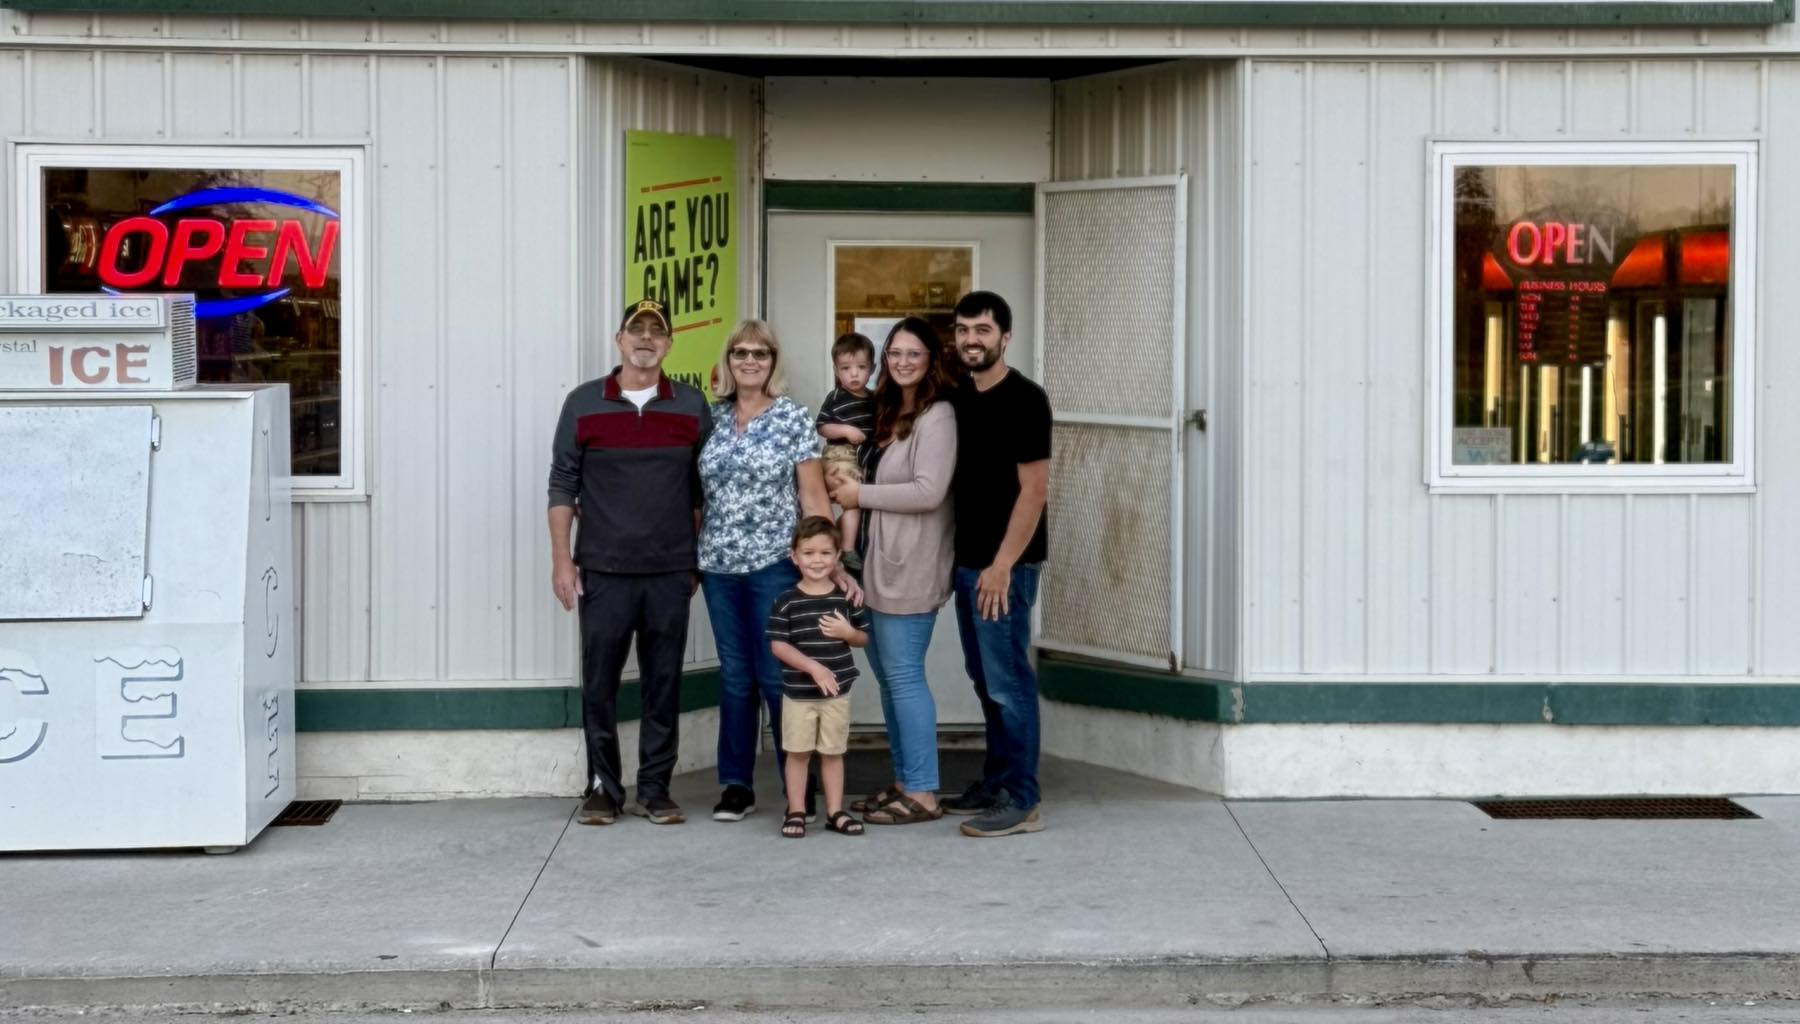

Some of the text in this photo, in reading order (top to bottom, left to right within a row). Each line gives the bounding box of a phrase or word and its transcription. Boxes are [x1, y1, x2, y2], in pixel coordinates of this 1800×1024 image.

[634, 192, 729, 263] ARE YOU
[1507, 221, 1616, 266] OPEN
[100, 216, 340, 289] OPEN
[643, 253, 719, 316] GAME?
[1568, 281, 1607, 293] HOURS
[111, 302, 151, 318] ice
[48, 343, 151, 385] ICE
